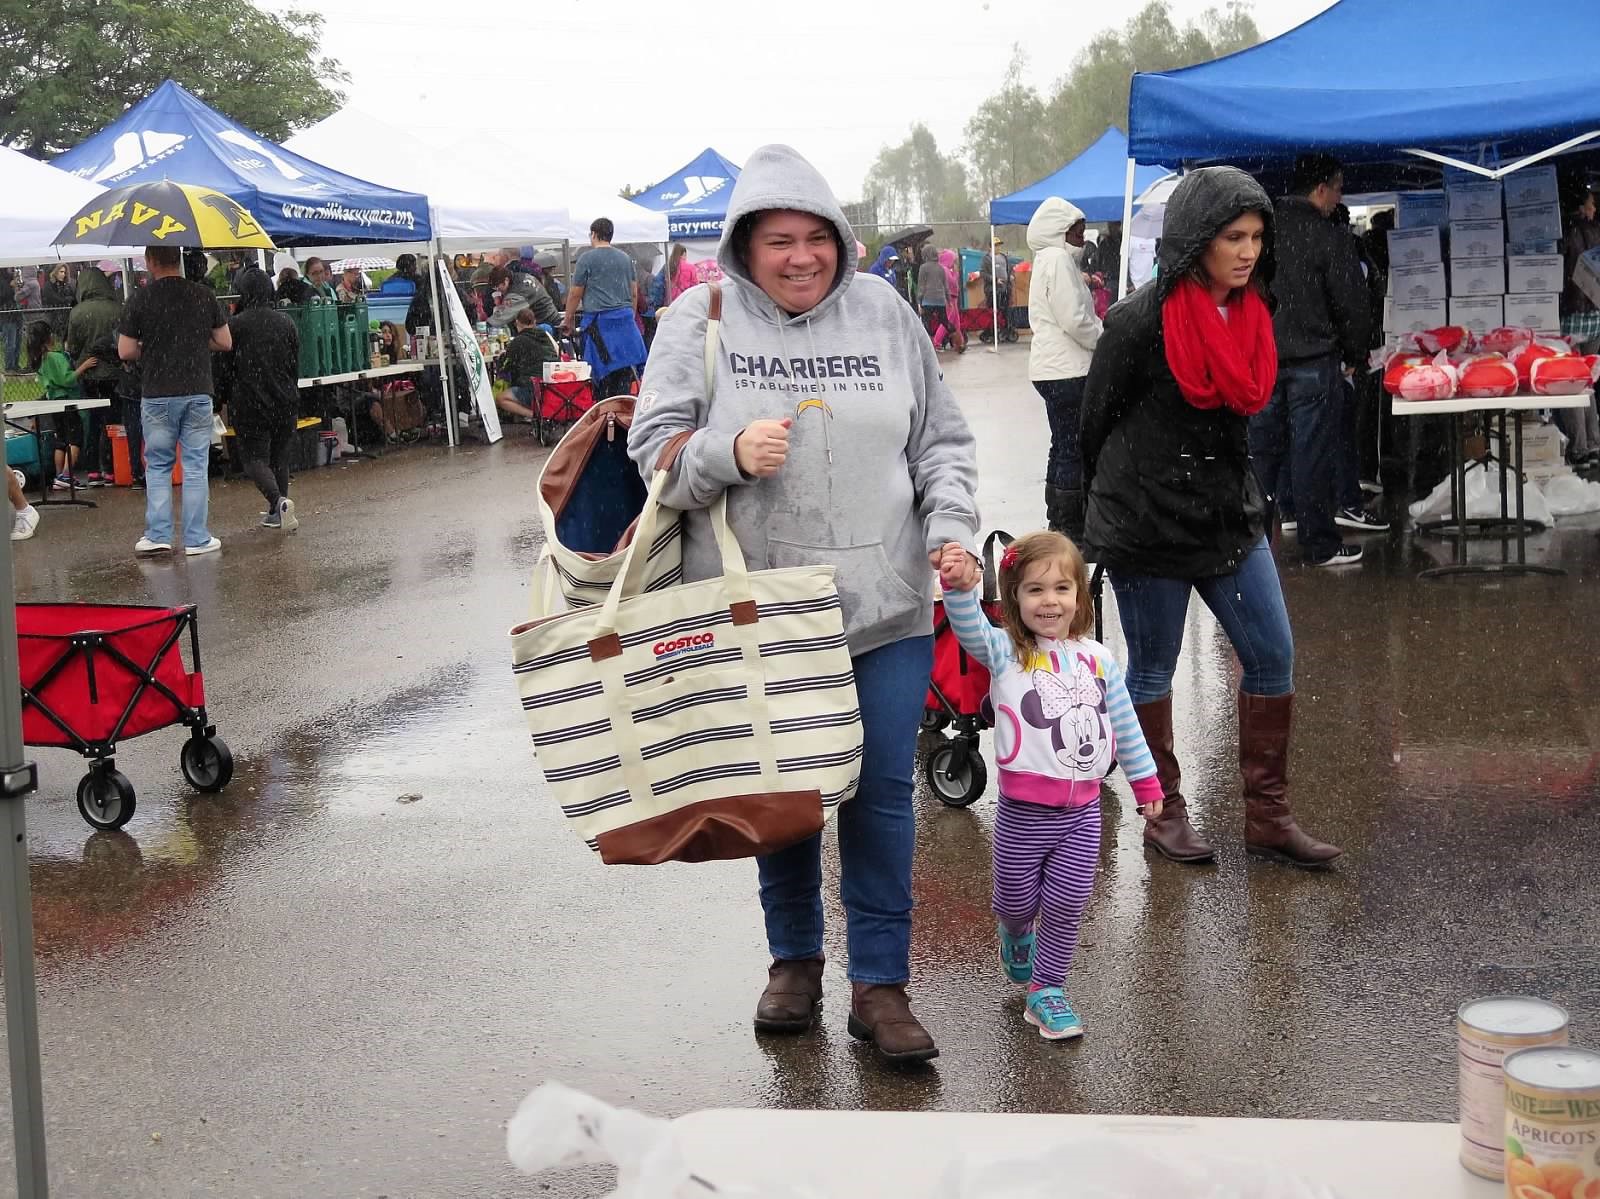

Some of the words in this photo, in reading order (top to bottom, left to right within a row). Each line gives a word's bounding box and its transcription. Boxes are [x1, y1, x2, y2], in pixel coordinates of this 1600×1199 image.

[231, 158, 266, 170] the
[75, 199, 187, 240] NAVY
[281, 201, 416, 231] www.militaryymca.org
[730, 352, 881, 379] CHARGERS
[833, 382, 847, 392] IN
[854, 382, 884, 392] 1960
[653, 632, 714, 656] COSTCO
[1567, 1098, 1600, 1119] WES
[1511, 1117, 1596, 1145] APRICOTS
